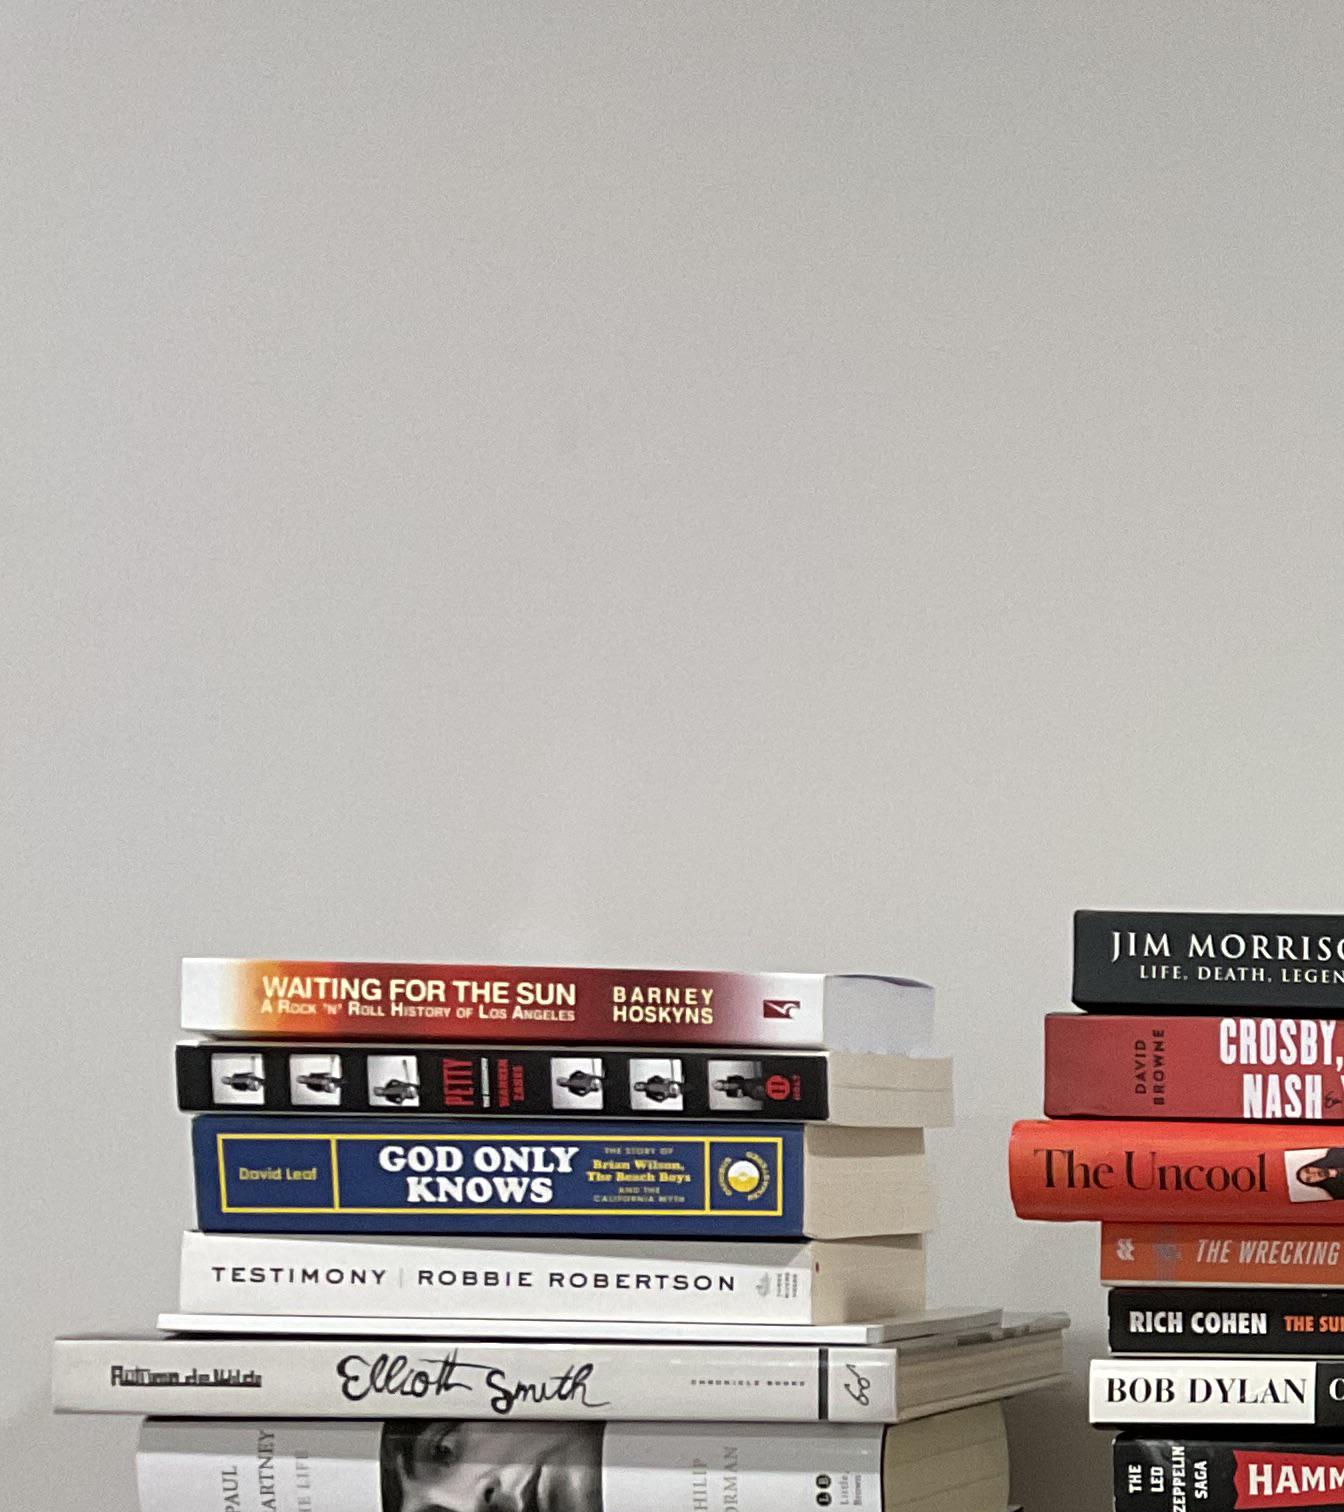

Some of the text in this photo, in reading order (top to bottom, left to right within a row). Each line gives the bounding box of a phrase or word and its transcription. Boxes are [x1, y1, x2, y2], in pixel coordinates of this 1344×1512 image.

[1110, 932, 1171, 962] JIM
[262, 975, 575, 1005] WAITING FOR THE SUN
[613, 986, 713, 1006] BARNEY
[261, 1002, 273, 1015] A
[278, 1002, 318, 1015] ROCK
[349, 1003, 385, 1016] ROLL
[391, 1004, 451, 1018] HISTORY
[456, 1007, 472, 1019] OF
[477, 1006, 507, 1021] LOS
[512, 1008, 575, 1022] ANGELES
[613, 1005, 713, 1024] HOSKYNS
[378, 1145, 578, 1173] GOD ONLY
[239, 1167, 280, 1182] David
[1034, 1148, 1268, 1194] The Uncool
[406, 1177, 553, 1203] KNOWS
[212, 1266, 386, 1285] TESTIMONY
[418, 1270, 735, 1293] ROBBIE ROBERTSON
[1129, 1311, 1267, 1335] RICH COHEN
[1285, 1316, 1315, 1332] THE
[1106, 1376, 1306, 1404] BOB DYLAN
